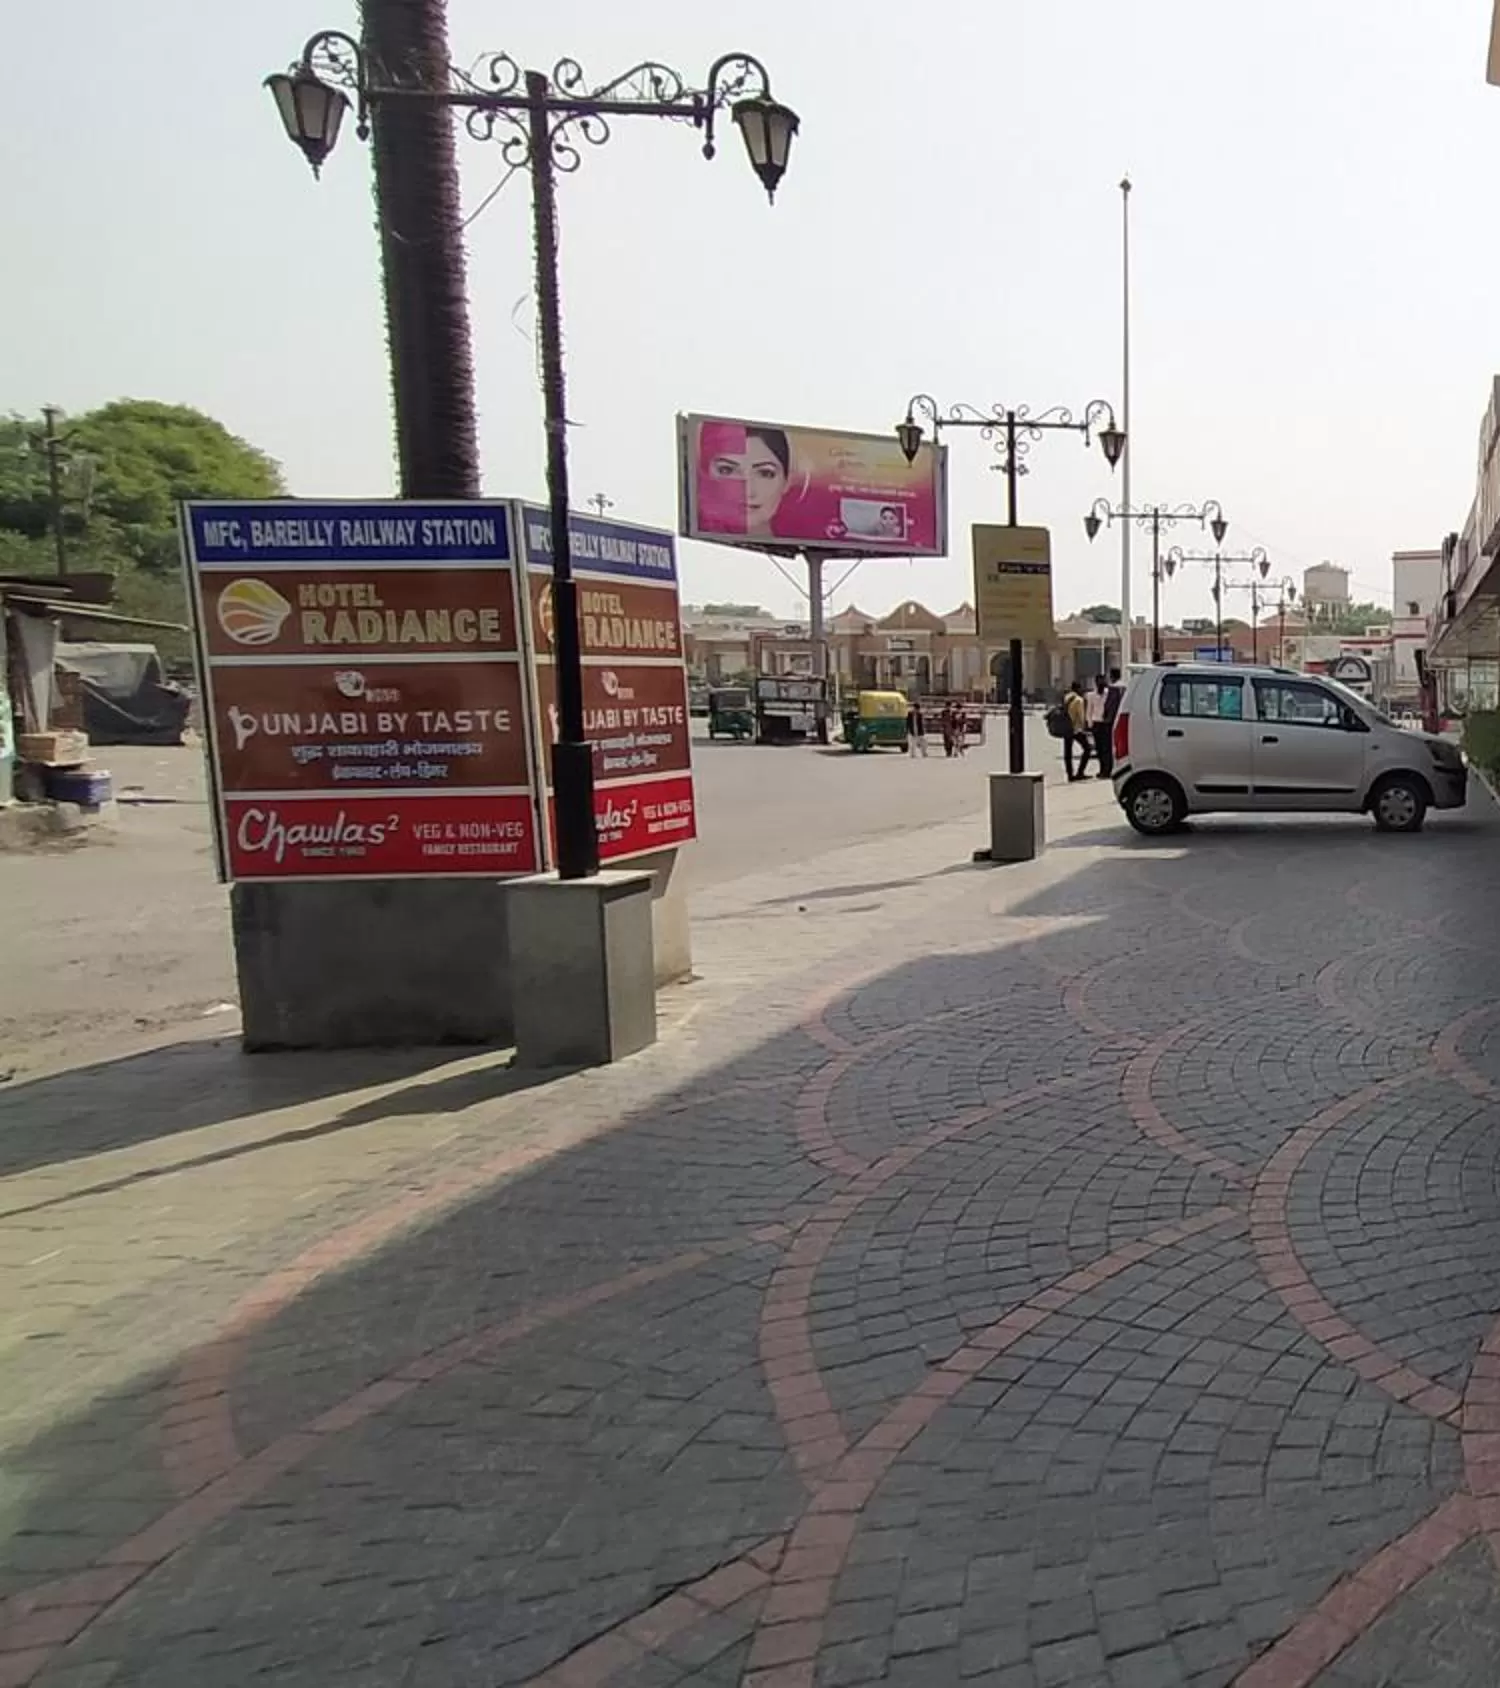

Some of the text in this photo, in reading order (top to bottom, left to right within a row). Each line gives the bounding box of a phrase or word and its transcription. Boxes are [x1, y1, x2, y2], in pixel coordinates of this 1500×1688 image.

[203, 519, 497, 552] MFC, BAREILLY RAILWAY STATION
[298, 583, 384, 607] HOTEL
[581, 591, 624, 615] HOTEL
[302, 609, 501, 644] RADIANCE
[583, 615, 677, 650] RADIANCE
[227, 705, 512, 750] PUNJABI BY TASTE
[623, 709, 639, 727] BY
[641, 706, 684, 726] TASTE
[412, 823, 441, 839] VEG
[459, 821, 525, 838] NON-VEG
